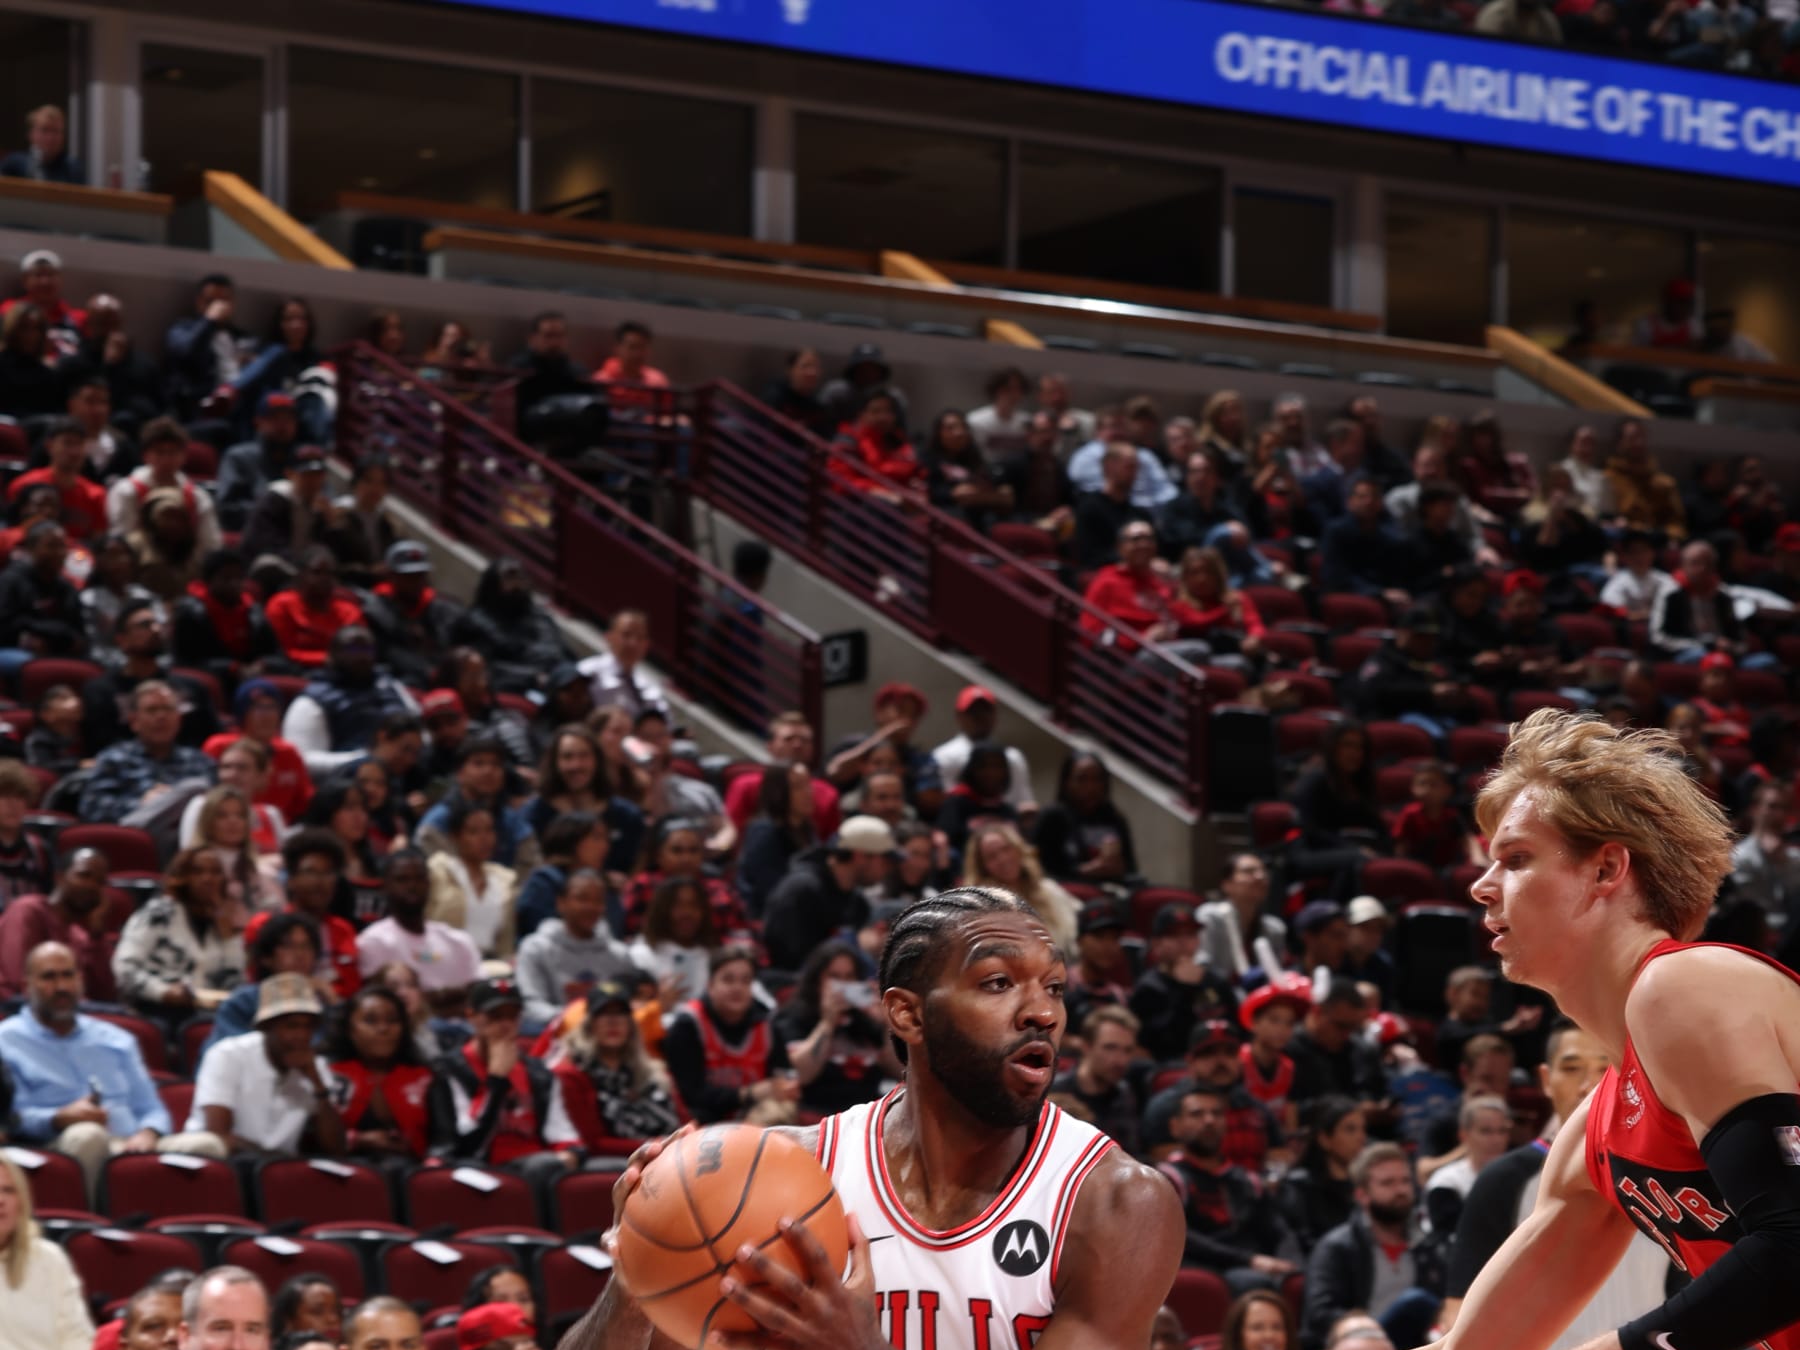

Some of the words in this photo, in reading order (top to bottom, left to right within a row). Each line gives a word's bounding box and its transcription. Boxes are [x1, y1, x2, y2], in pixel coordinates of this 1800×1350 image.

[1214, 32, 1415, 106] OFFICIAL
[1421, 61, 1590, 130] AIRLINE
[1594, 85, 1652, 137] OF
[1655, 92, 1739, 150] THE
